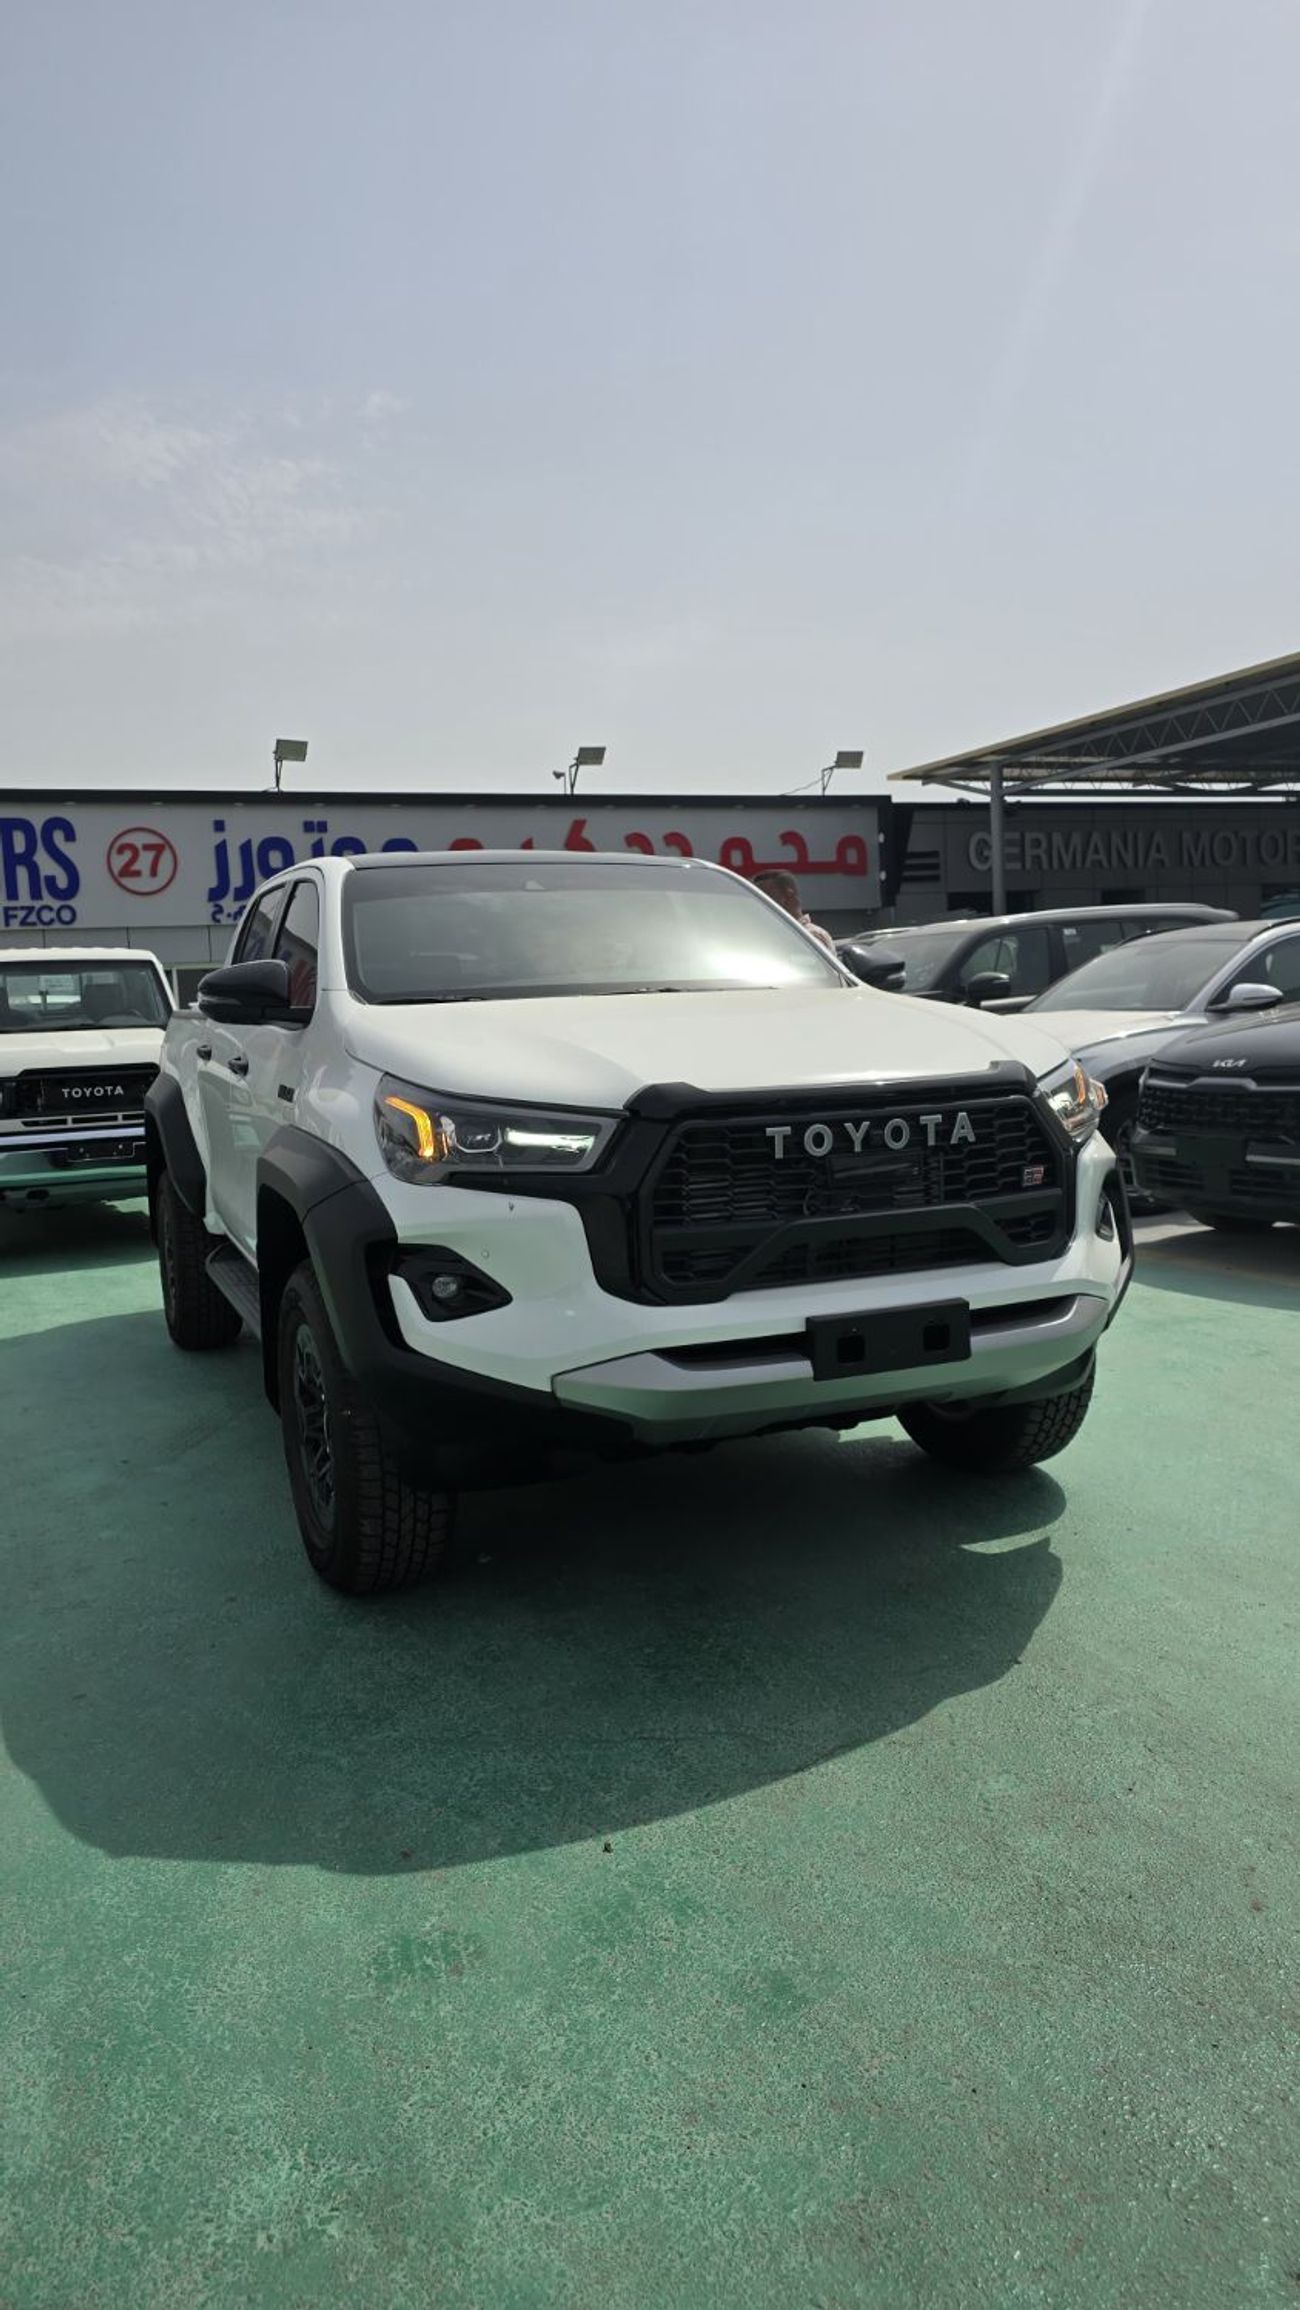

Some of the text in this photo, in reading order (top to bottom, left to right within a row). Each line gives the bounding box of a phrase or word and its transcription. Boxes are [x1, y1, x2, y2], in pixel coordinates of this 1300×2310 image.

[116, 842, 166, 878] 27
[968, 831, 1169, 871] GERMANIA
[3, 904, 77, 927] FZCO
[61, 1085, 124, 1098] TOYOTA
[766, 1112, 976, 1159] TOYOTA
